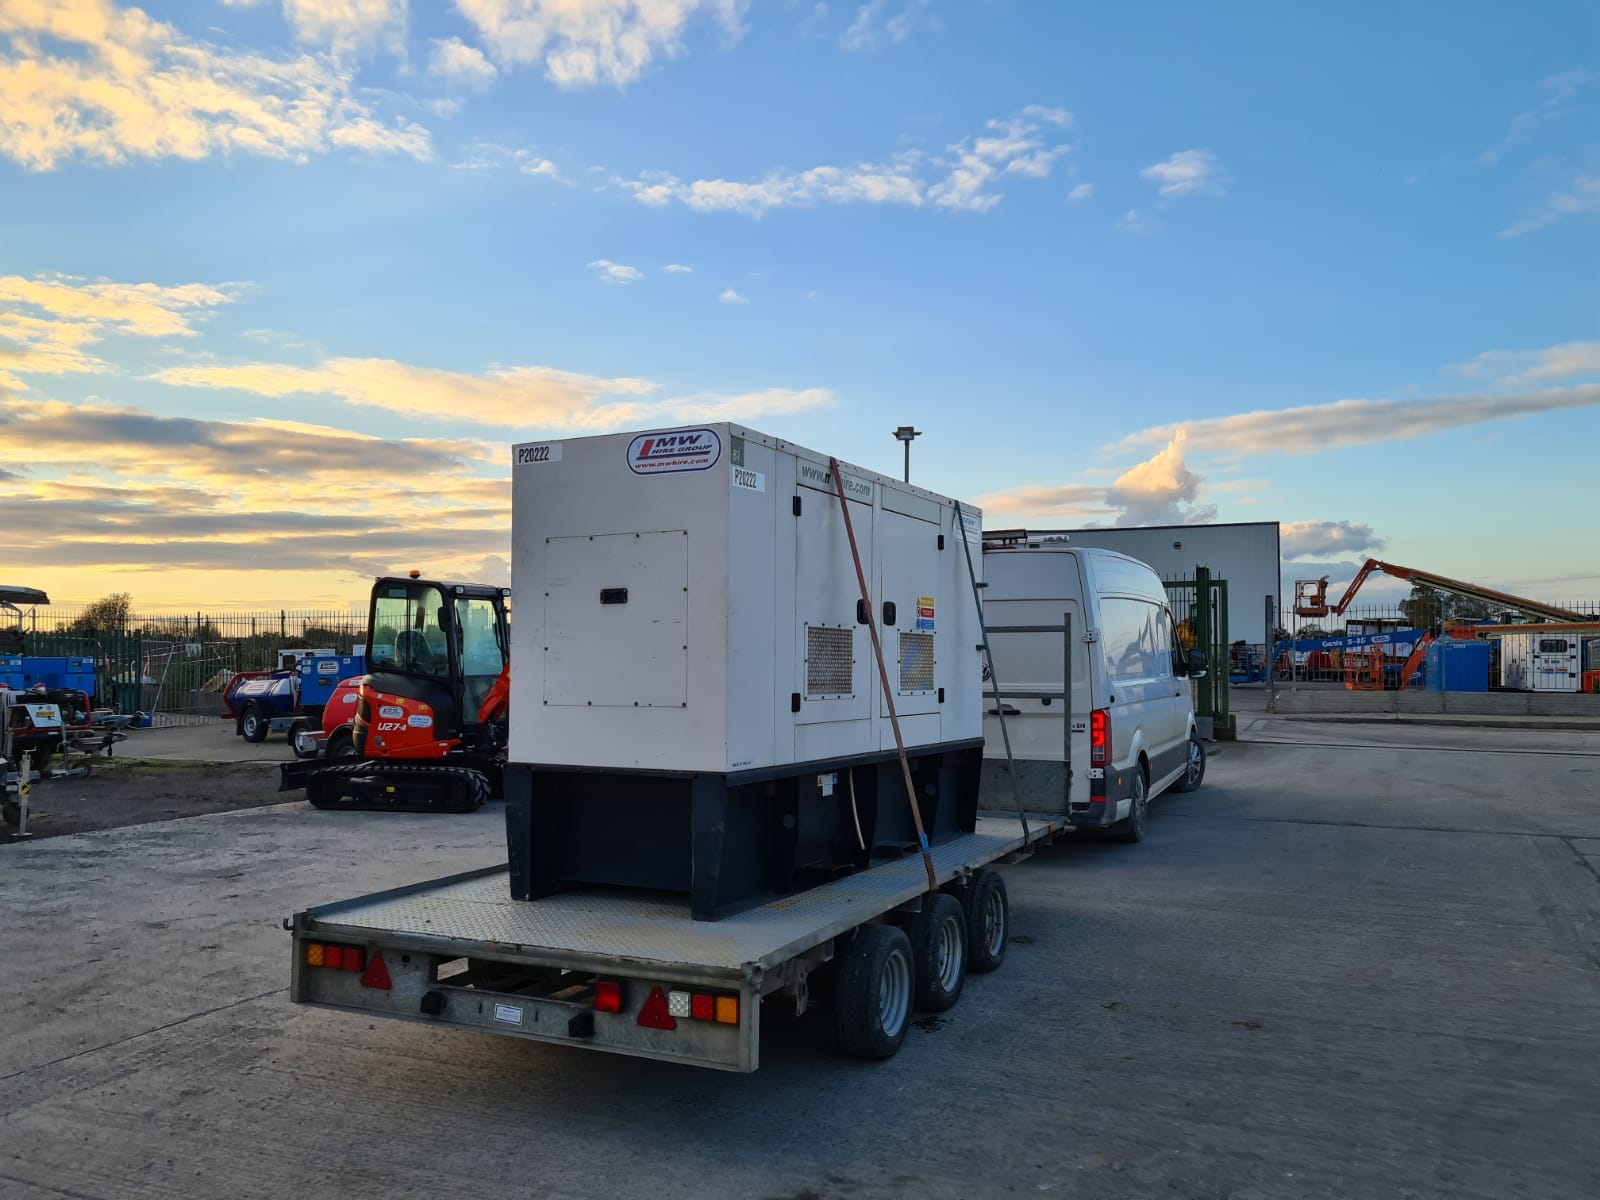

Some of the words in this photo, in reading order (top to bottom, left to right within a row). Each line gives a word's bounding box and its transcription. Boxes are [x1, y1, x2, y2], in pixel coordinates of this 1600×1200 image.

[518, 446, 550, 464] P20222
[651, 447, 675, 455] HIRE
[678, 444, 713, 452] GROUP
[634, 458, 709, 469] www.mwhire.com
[734, 469, 757, 488] P20222
[801, 465, 871, 497] www.mire.com
[377, 722, 407, 731] U27-4
